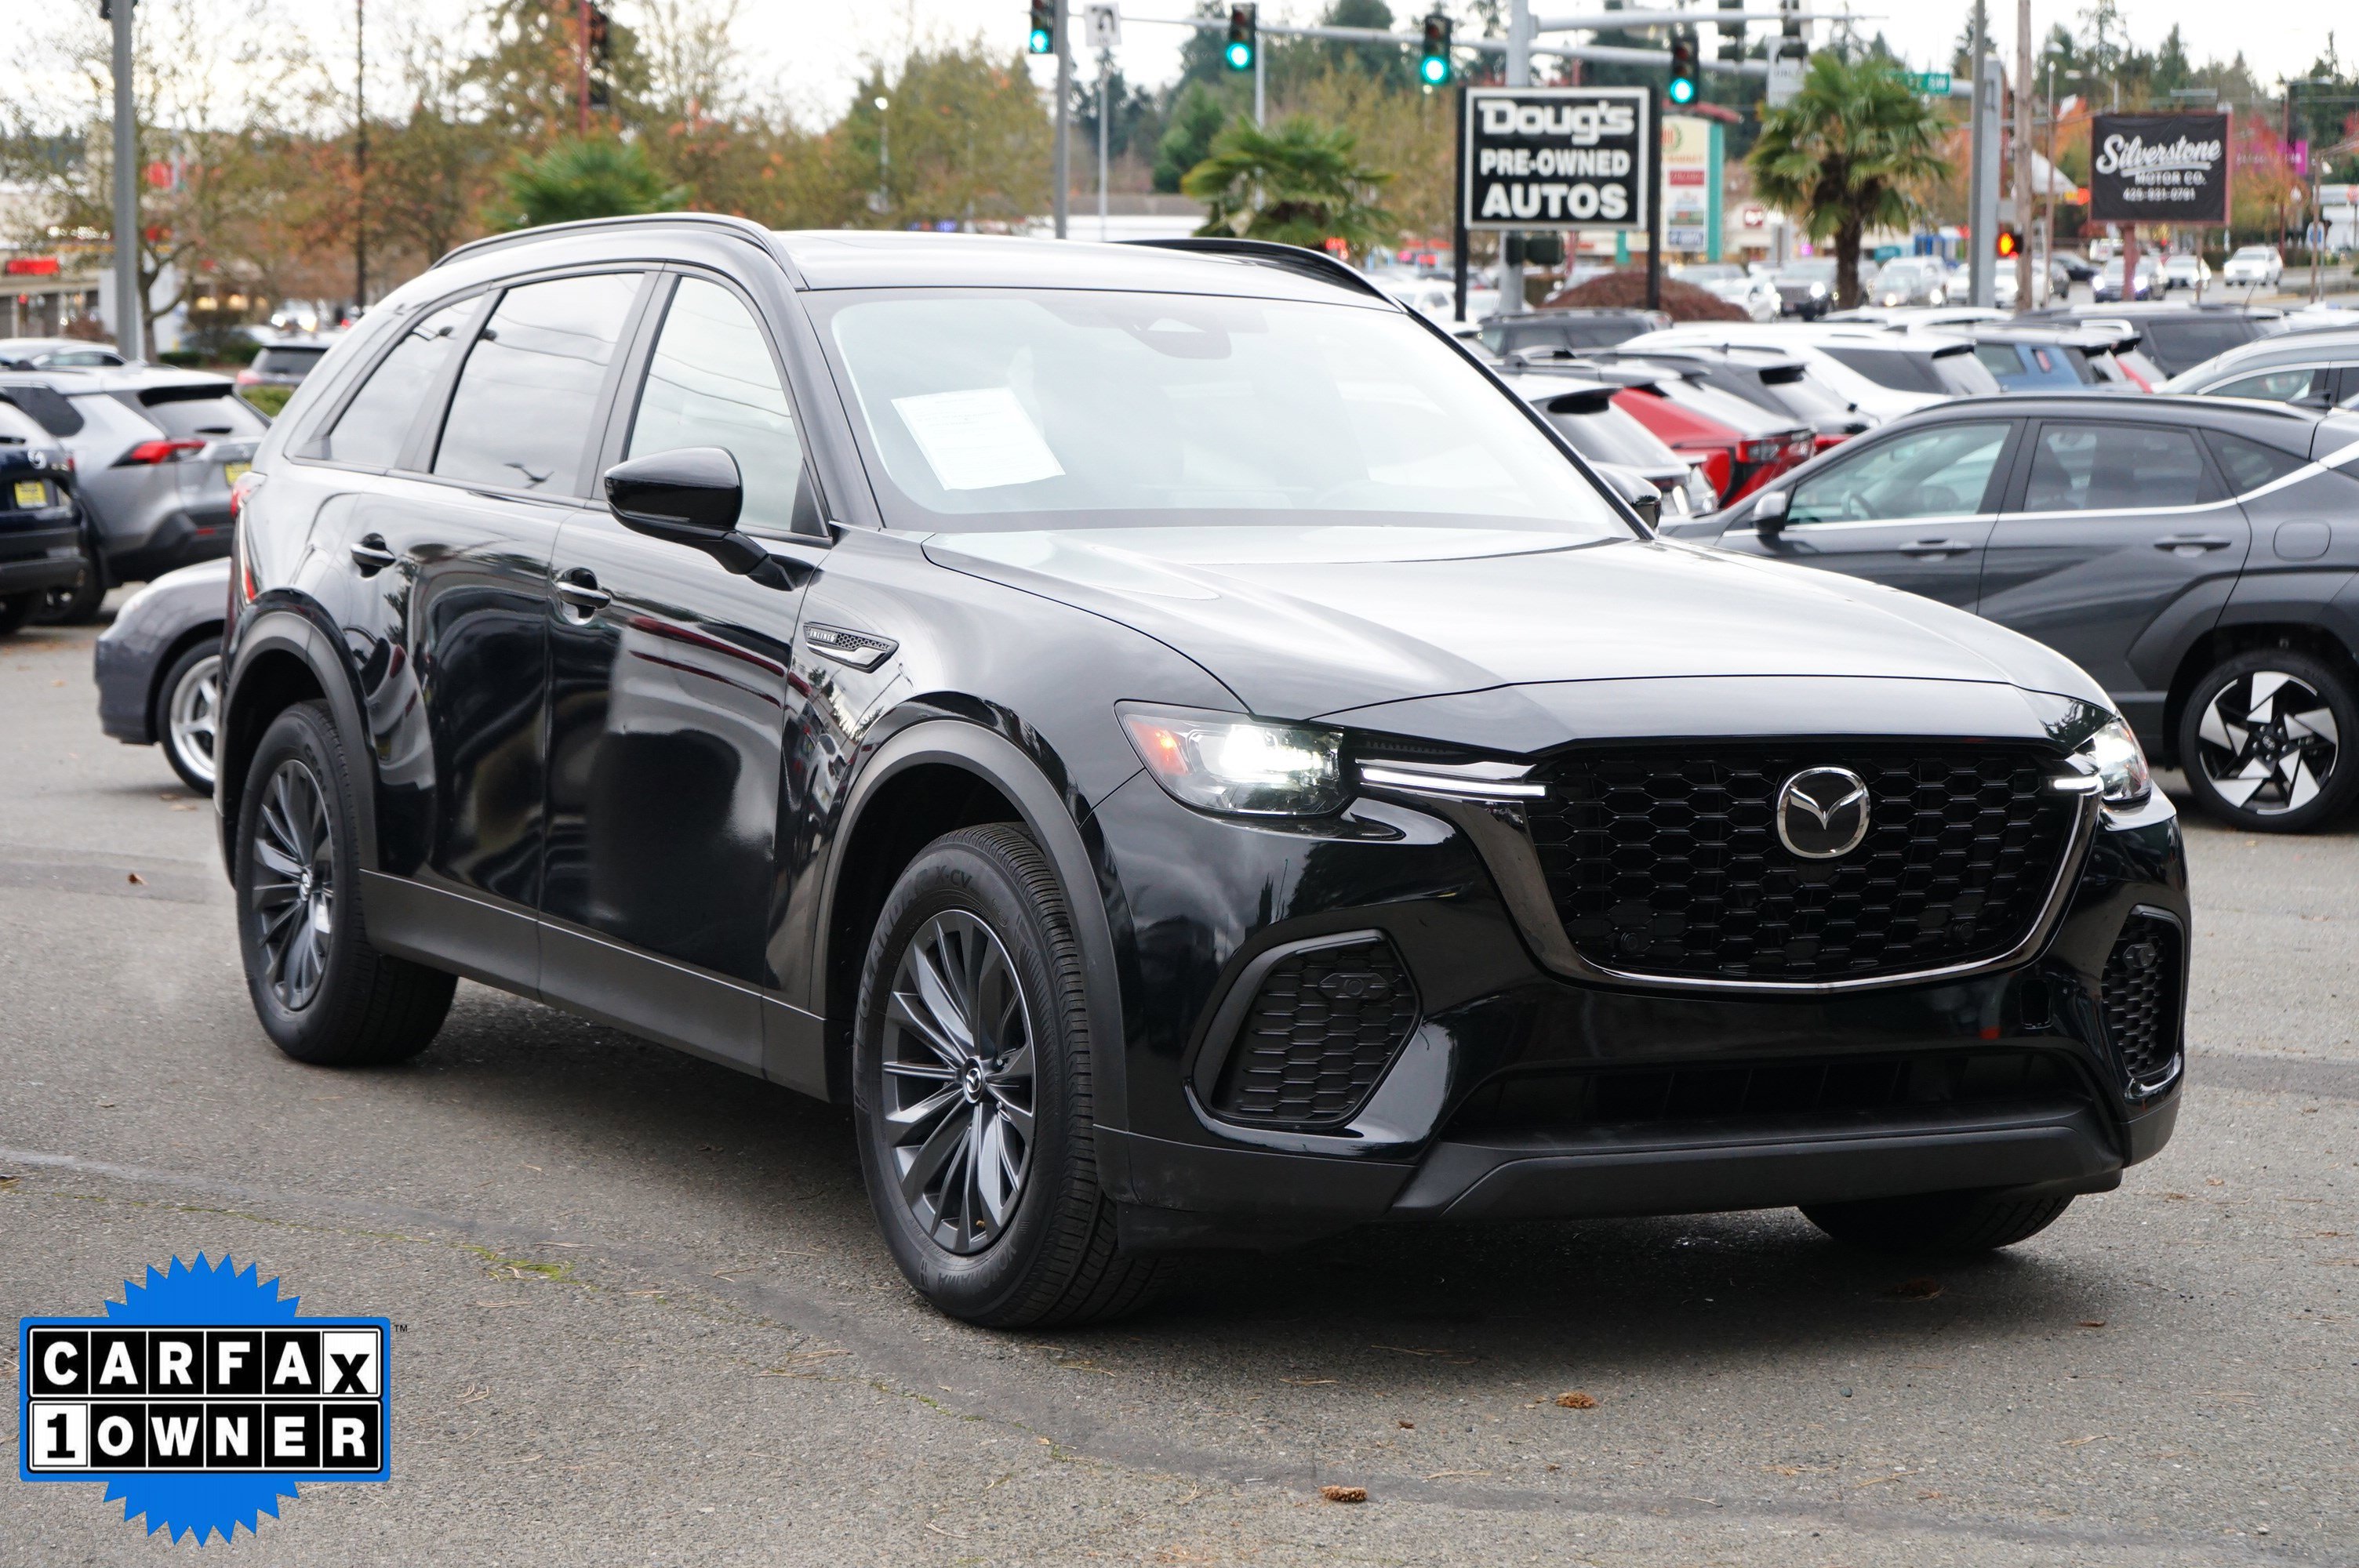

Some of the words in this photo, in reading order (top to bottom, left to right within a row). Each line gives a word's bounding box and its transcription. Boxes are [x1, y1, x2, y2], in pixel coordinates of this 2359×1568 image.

[1480, 148, 1631, 177] PRE-OWNED
[2095, 133, 2222, 175] Silverstone
[2135, 171, 2181, 185] MOTOR
[2183, 171, 2207, 186] CO.
[1481, 183, 1628, 219] AUTOS
[934, 865, 972, 889] X-CV
